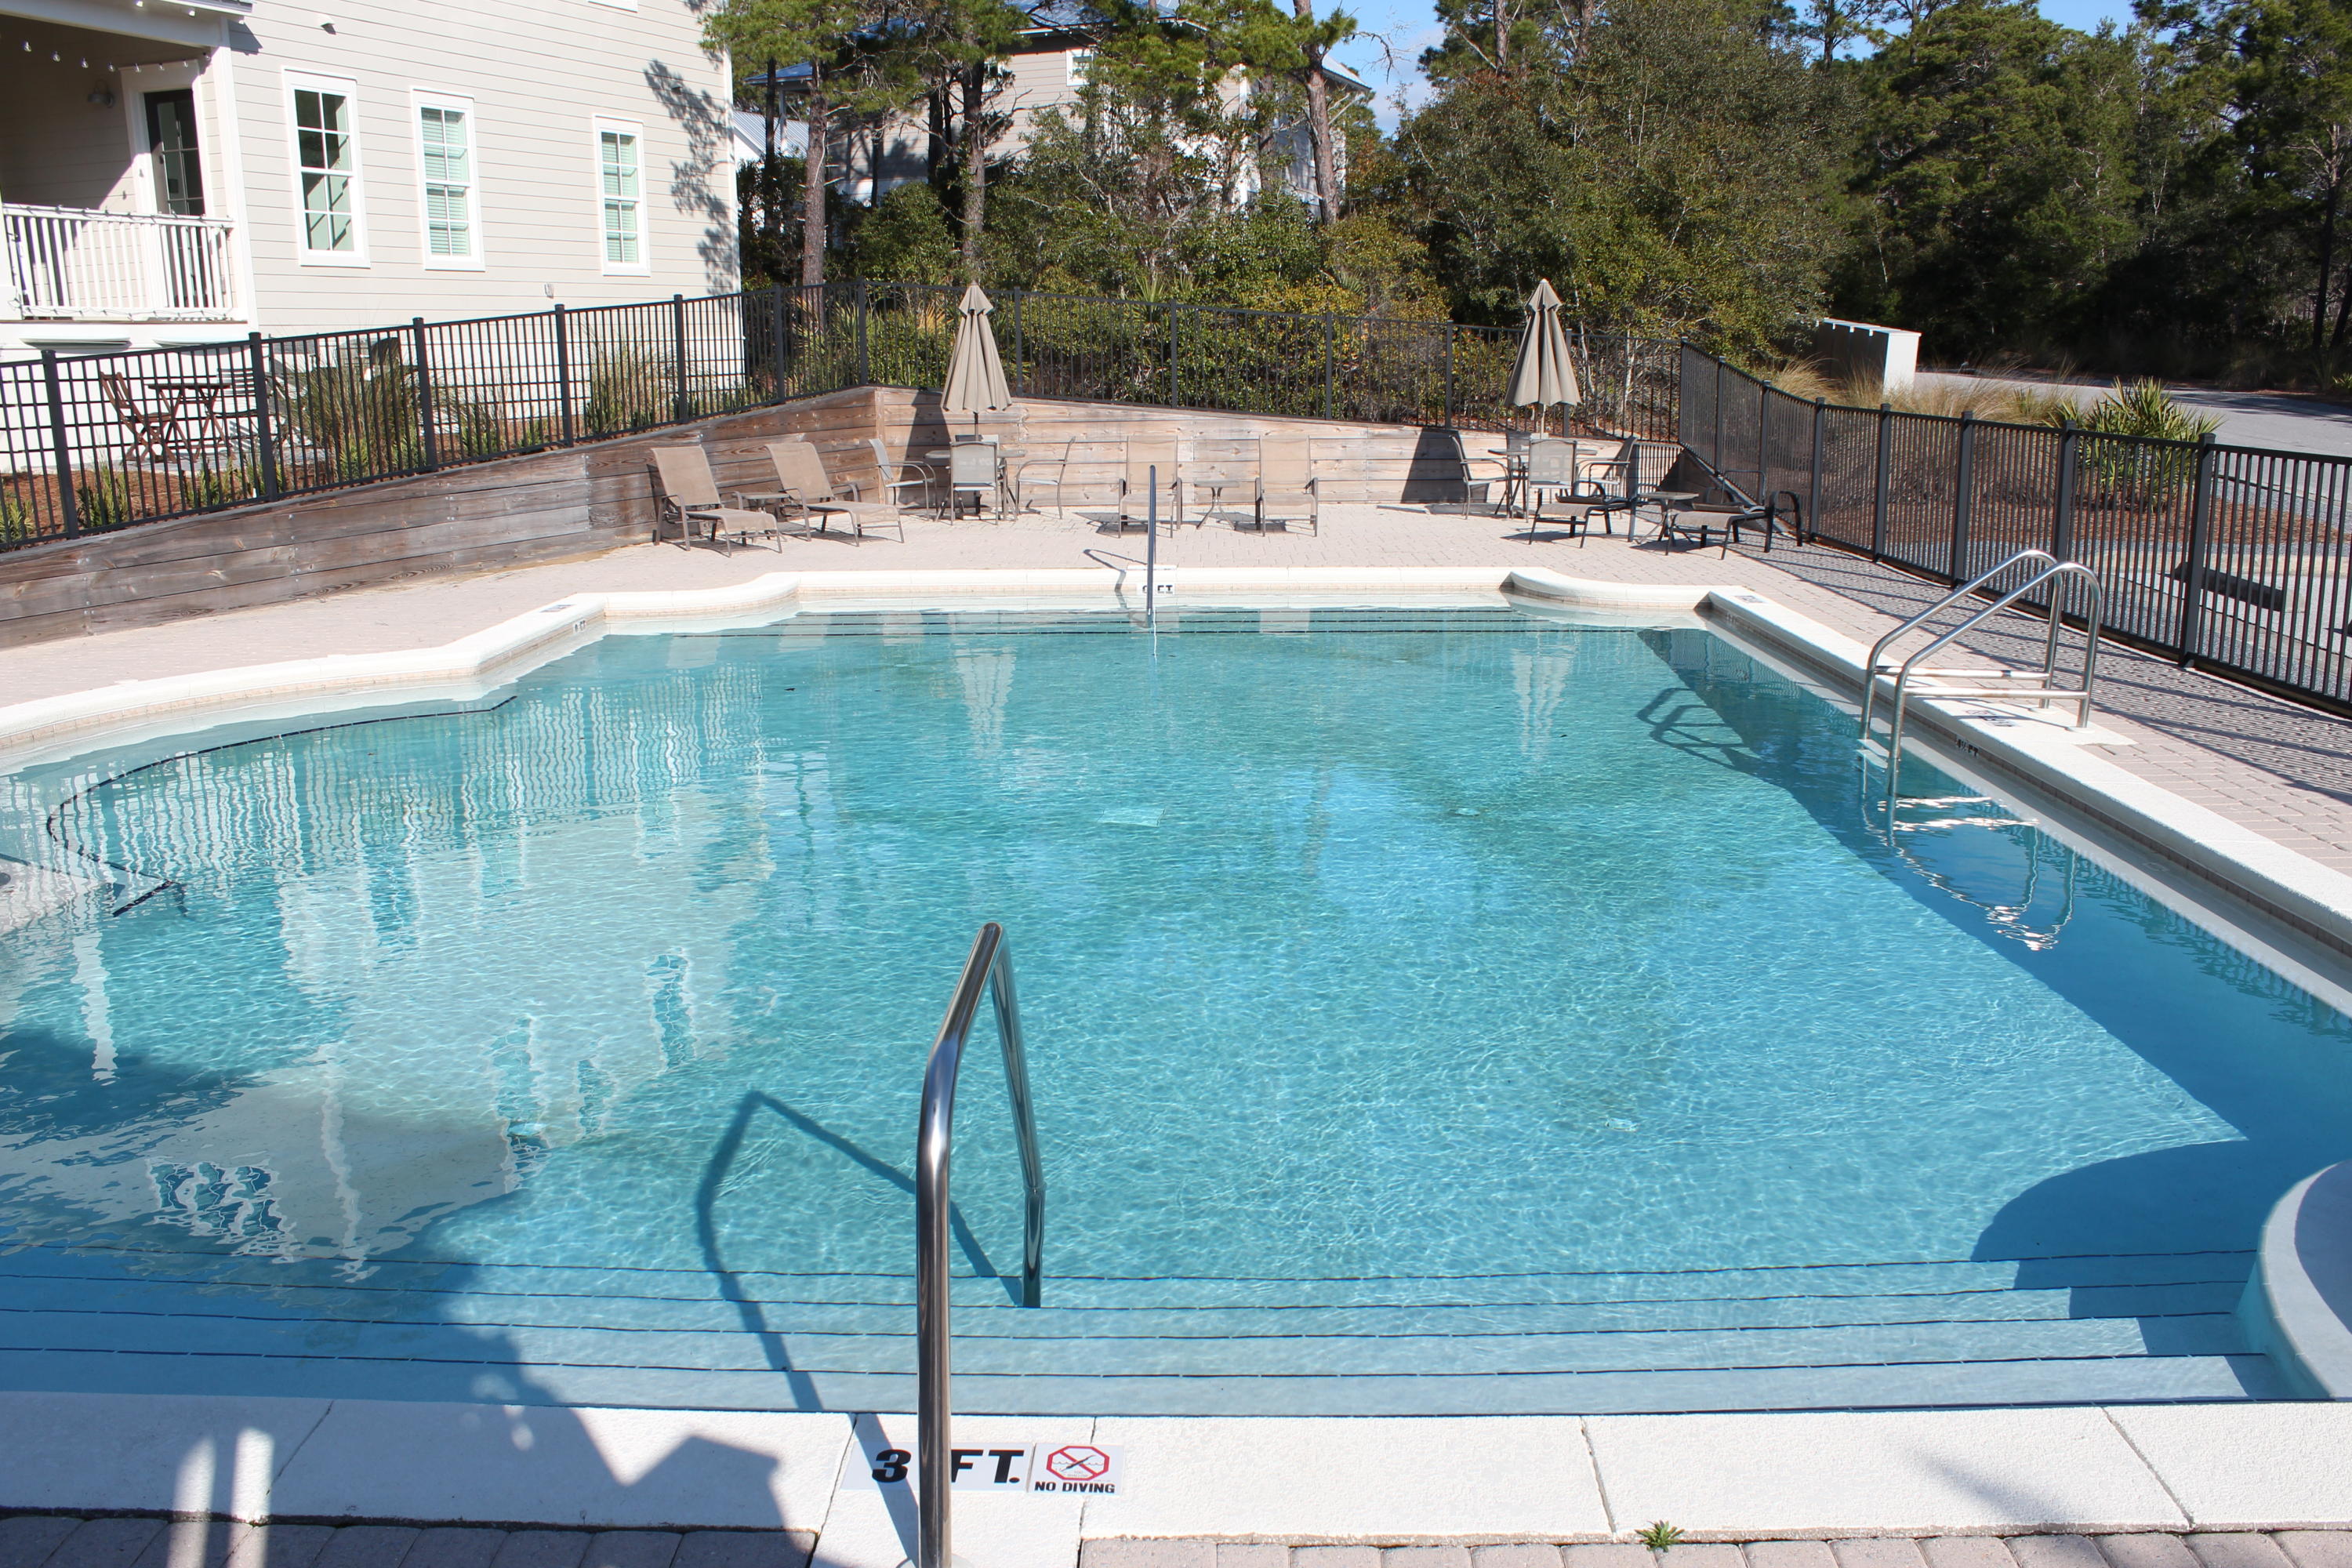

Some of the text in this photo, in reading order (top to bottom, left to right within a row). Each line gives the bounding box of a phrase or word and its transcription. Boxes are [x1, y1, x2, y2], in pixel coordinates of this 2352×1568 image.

[872, 1449, 1024, 1483] 3 FT.
[1034, 1481, 1115, 1494] NO DIVING
